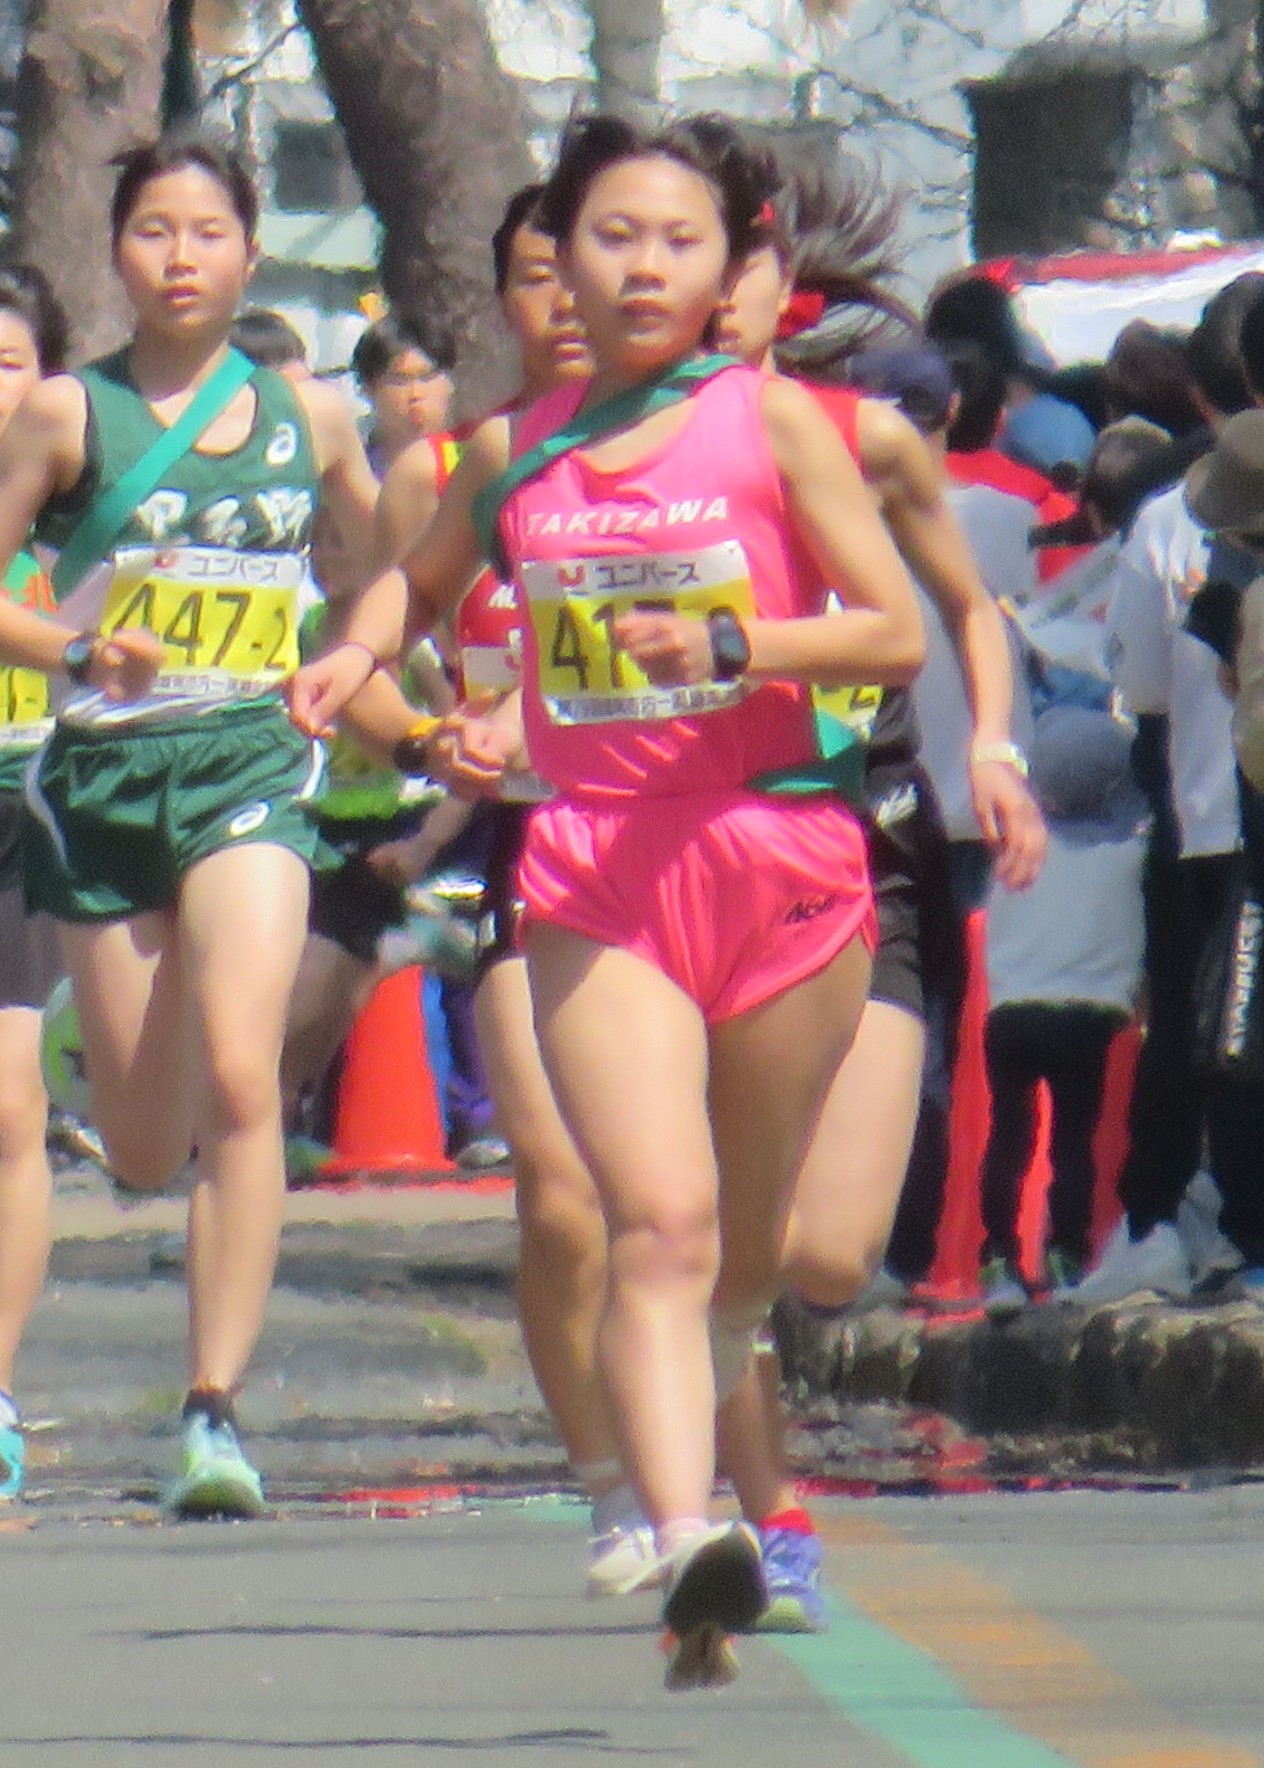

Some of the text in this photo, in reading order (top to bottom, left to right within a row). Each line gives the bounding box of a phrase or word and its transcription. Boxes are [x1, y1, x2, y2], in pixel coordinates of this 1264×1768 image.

[524, 496, 729, 536] TAKIZAWA
[596, 561, 701, 590] ユニバース
[551, 598, 676, 690] 41
